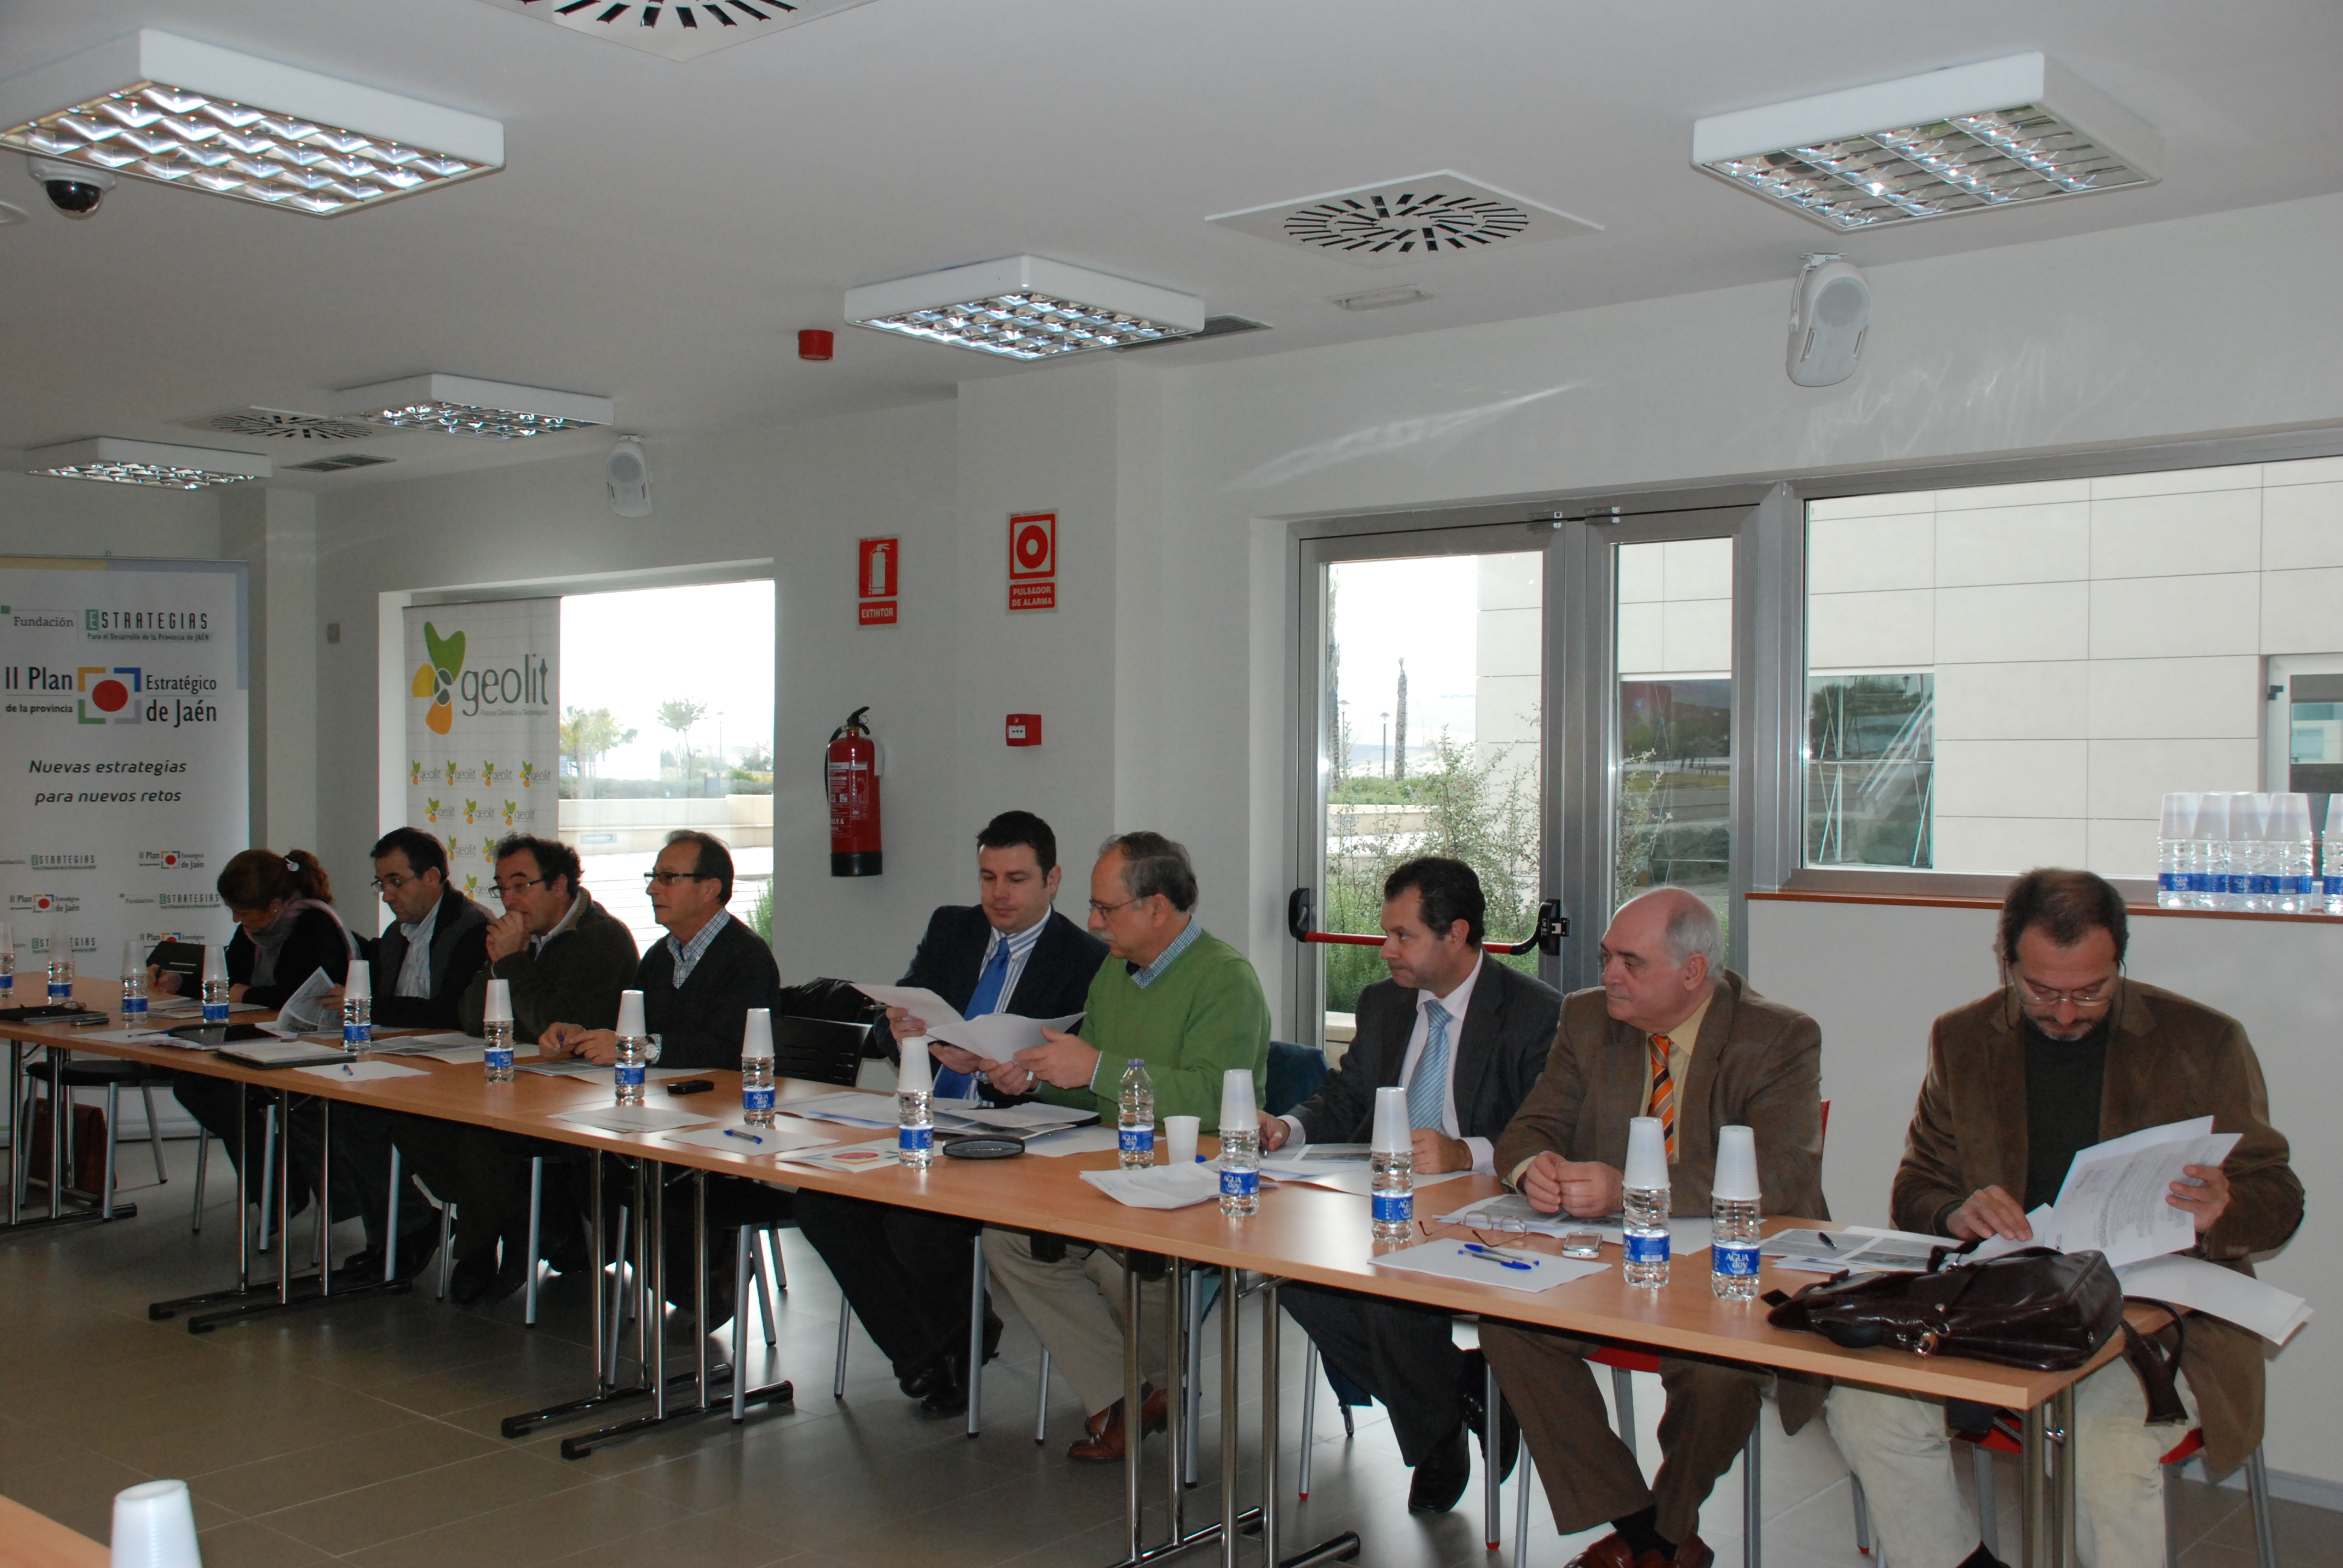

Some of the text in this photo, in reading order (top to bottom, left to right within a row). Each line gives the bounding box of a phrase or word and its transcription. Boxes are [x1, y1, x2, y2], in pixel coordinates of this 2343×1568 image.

[1014, 586, 1051, 595] PULSADOR
[1023, 597, 1052, 606] ALARMA
[862, 607, 894, 618] EXTINTOR
[13, 616, 74, 627] Fundación
[88, 610, 208, 630] ESTRATEGIAS
[5, 667, 73, 690] II Plan
[146, 675, 217, 695] Estratégico
[461, 653, 549, 717] geolit
[6, 704, 18, 713] de
[30, 705, 73, 714] provincia
[146, 699, 217, 728] de Jaén
[29, 760, 187, 776] Nuevas estrategias
[34, 789, 182, 806] para nuevos retos
[1121, 1133, 1137, 1142] AGUA
[1725, 1253, 1749, 1262] AGUA
